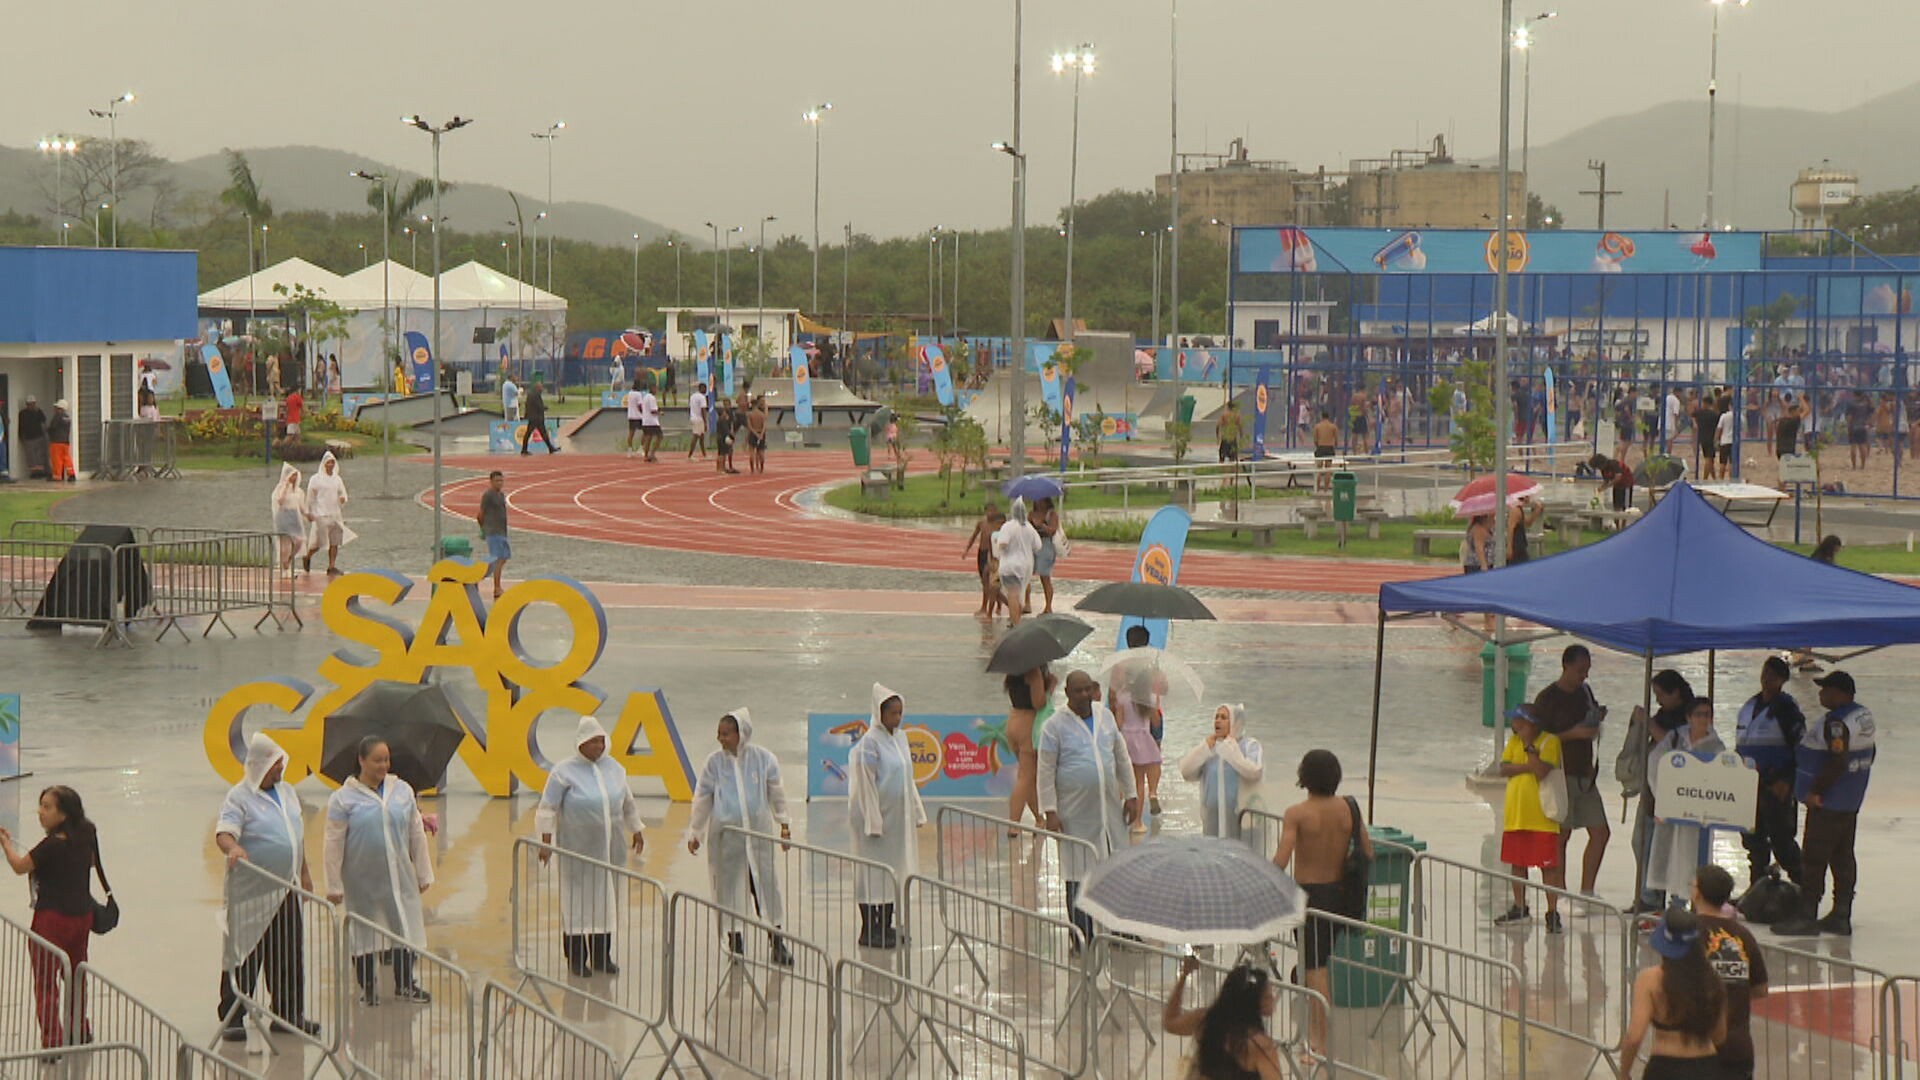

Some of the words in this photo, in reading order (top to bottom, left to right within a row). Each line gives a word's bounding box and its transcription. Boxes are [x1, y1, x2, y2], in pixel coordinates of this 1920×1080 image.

[318, 556, 605, 690] SÃO
[948, 743, 966, 751] Vem
[911, 750, 937, 764] RÃO
[1676, 787, 1736, 802] CICLOVIA
